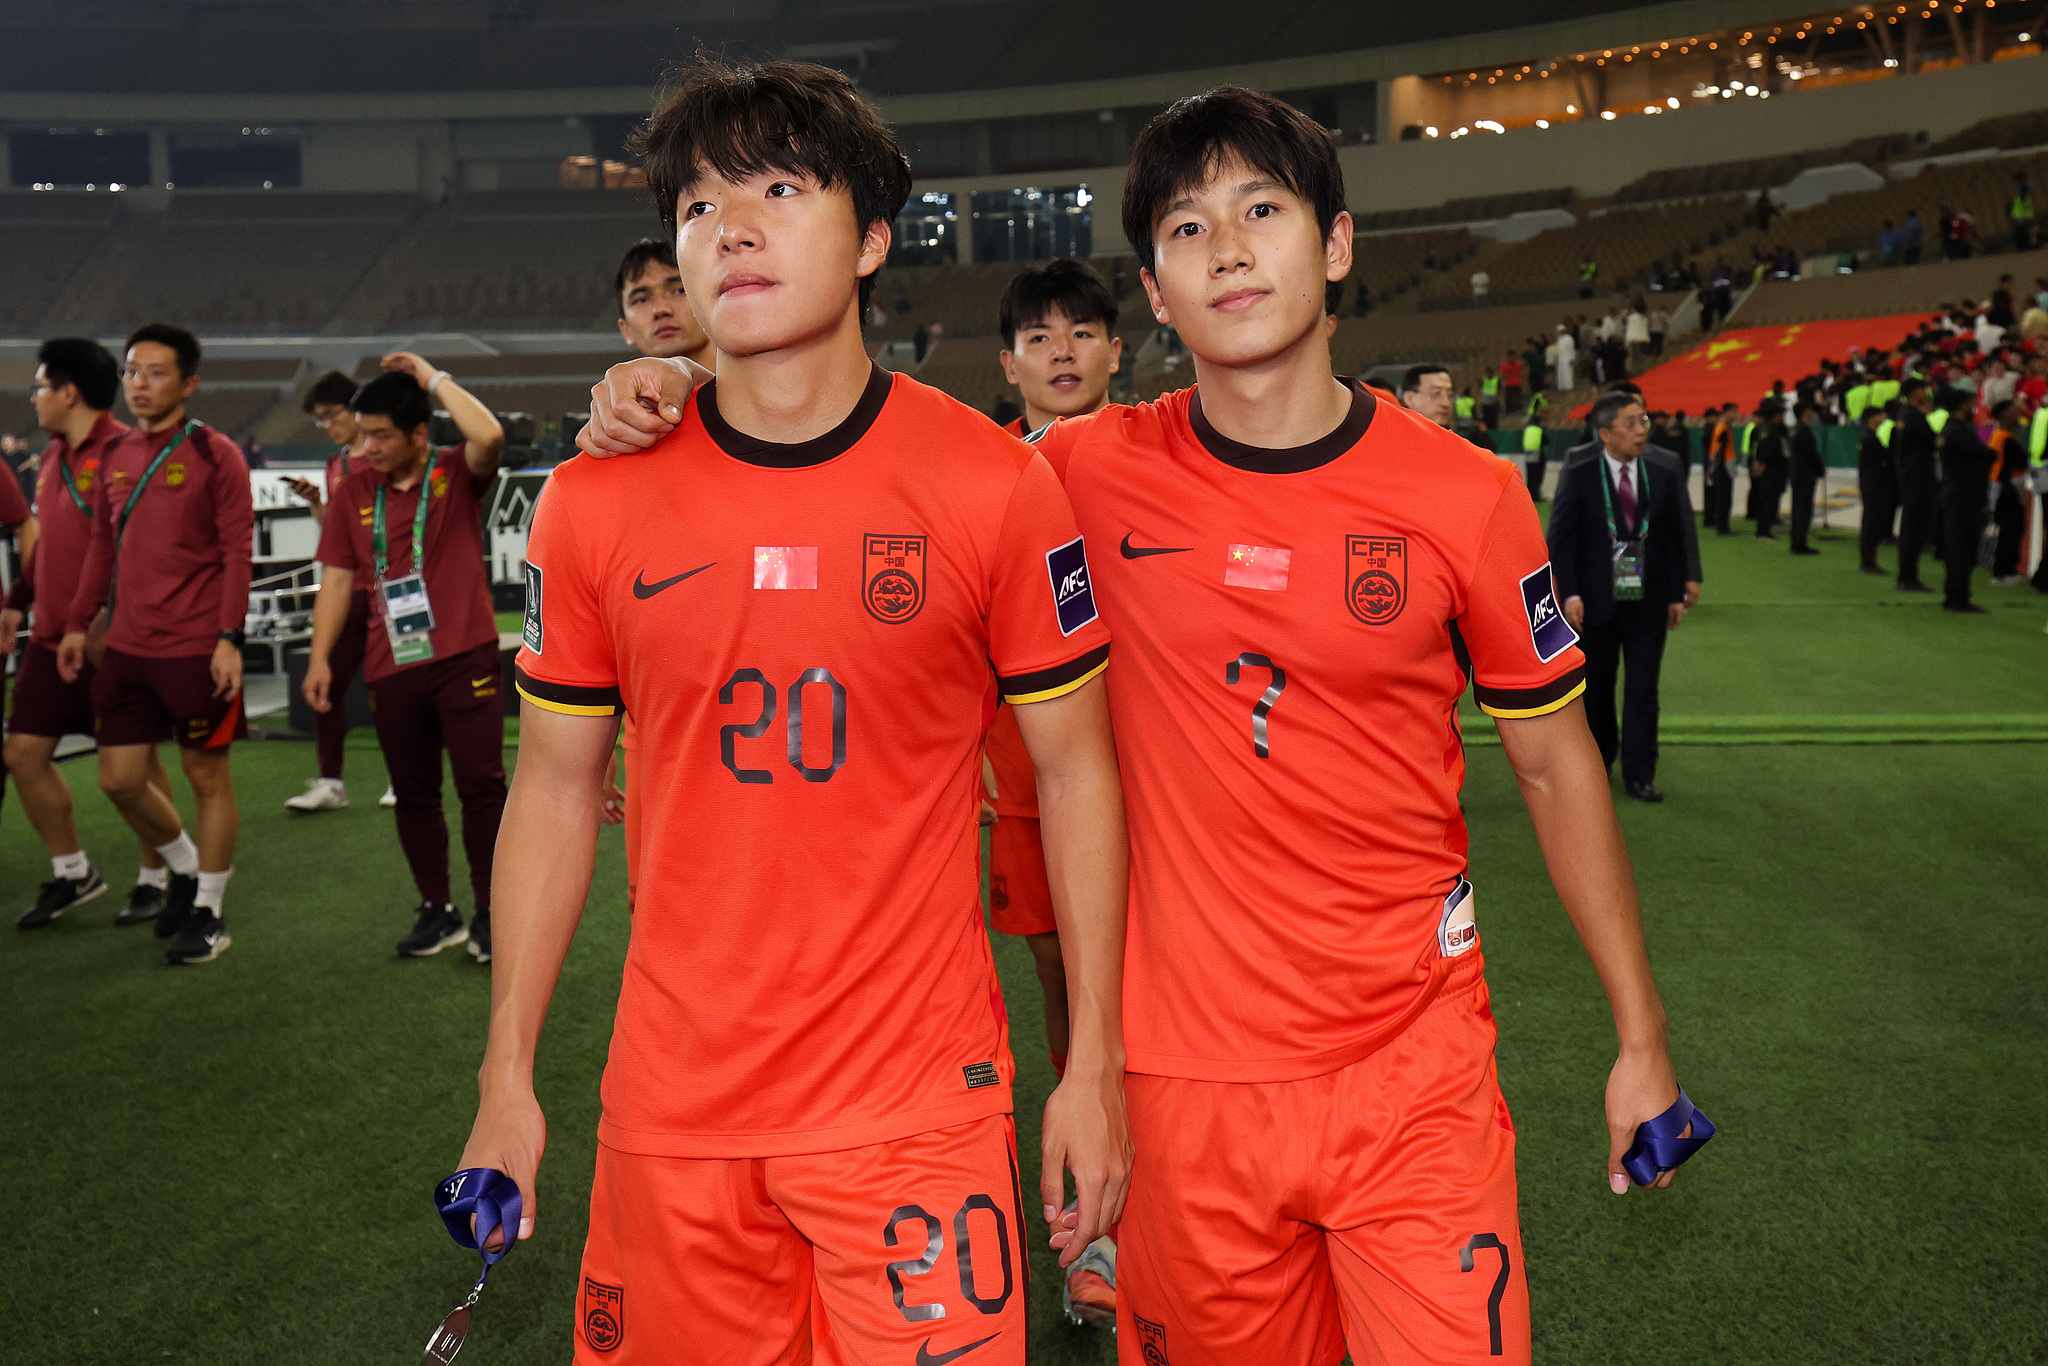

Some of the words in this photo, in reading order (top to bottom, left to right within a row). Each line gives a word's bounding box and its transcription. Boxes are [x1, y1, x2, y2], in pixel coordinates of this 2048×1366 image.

[869, 540, 921, 557] CFA
[1352, 541, 1402, 558] CFA
[1058, 565, 1086, 600] AFC
[1533, 592, 1554, 628] AFC
[1226, 651, 1286, 758] 7
[718, 668, 847, 784] 20
[884, 1194, 1013, 1322] 20
[587, 1283, 619, 1305] CFA
[1459, 1232, 1511, 1356] 7
[1136, 1319, 1163, 1341] CFA
